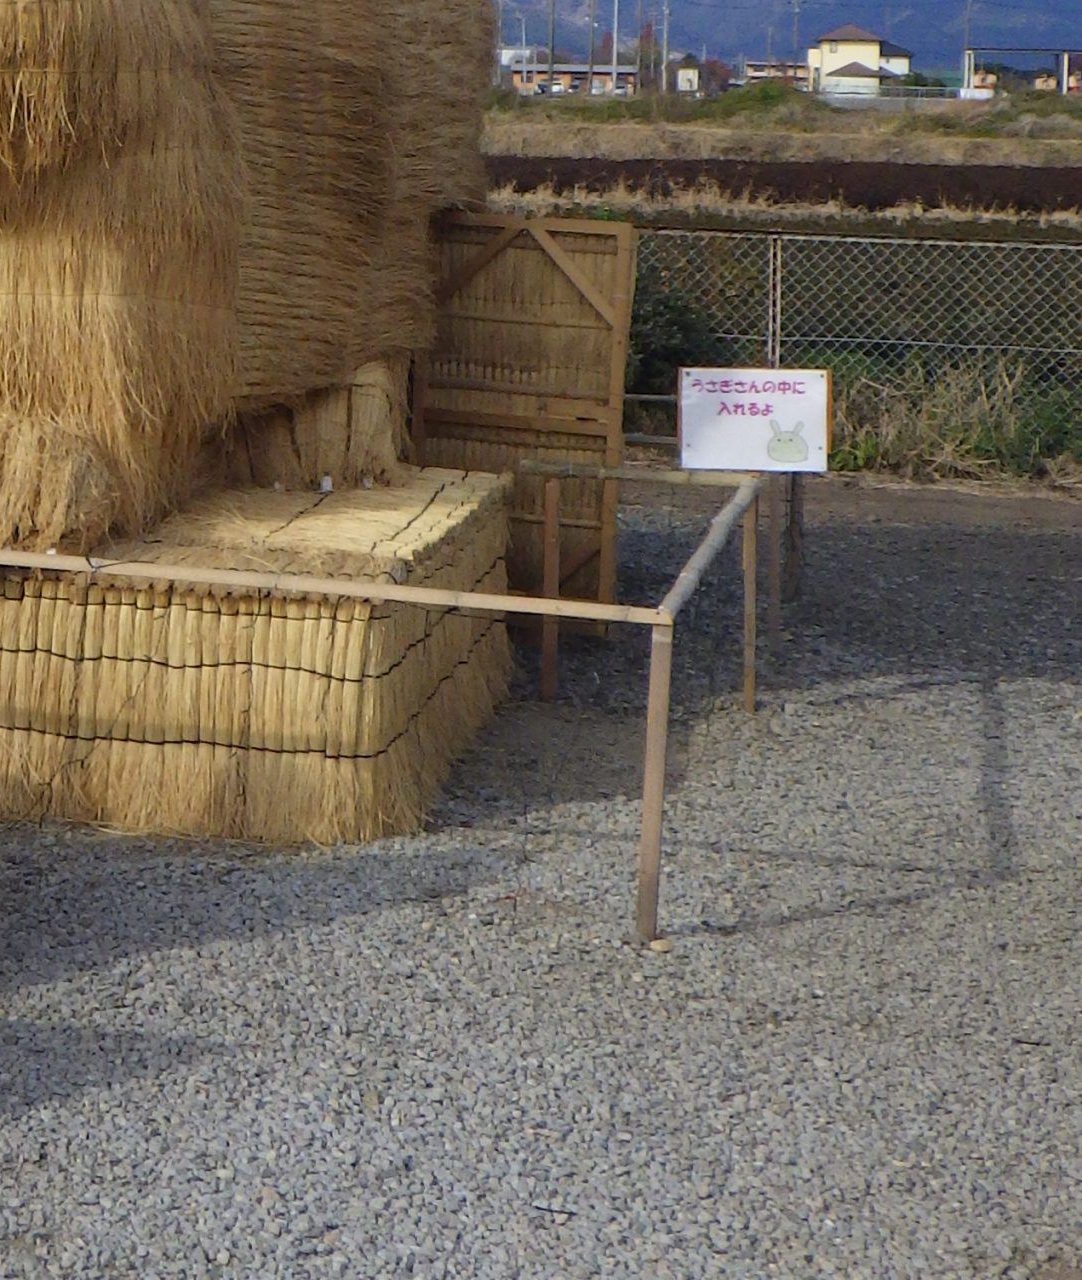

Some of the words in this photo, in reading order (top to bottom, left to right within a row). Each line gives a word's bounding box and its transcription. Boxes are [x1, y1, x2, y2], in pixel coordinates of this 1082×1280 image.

[691, 379, 806, 395] うさぎさんの中に
[717, 401, 774, 416] 入れるよ
